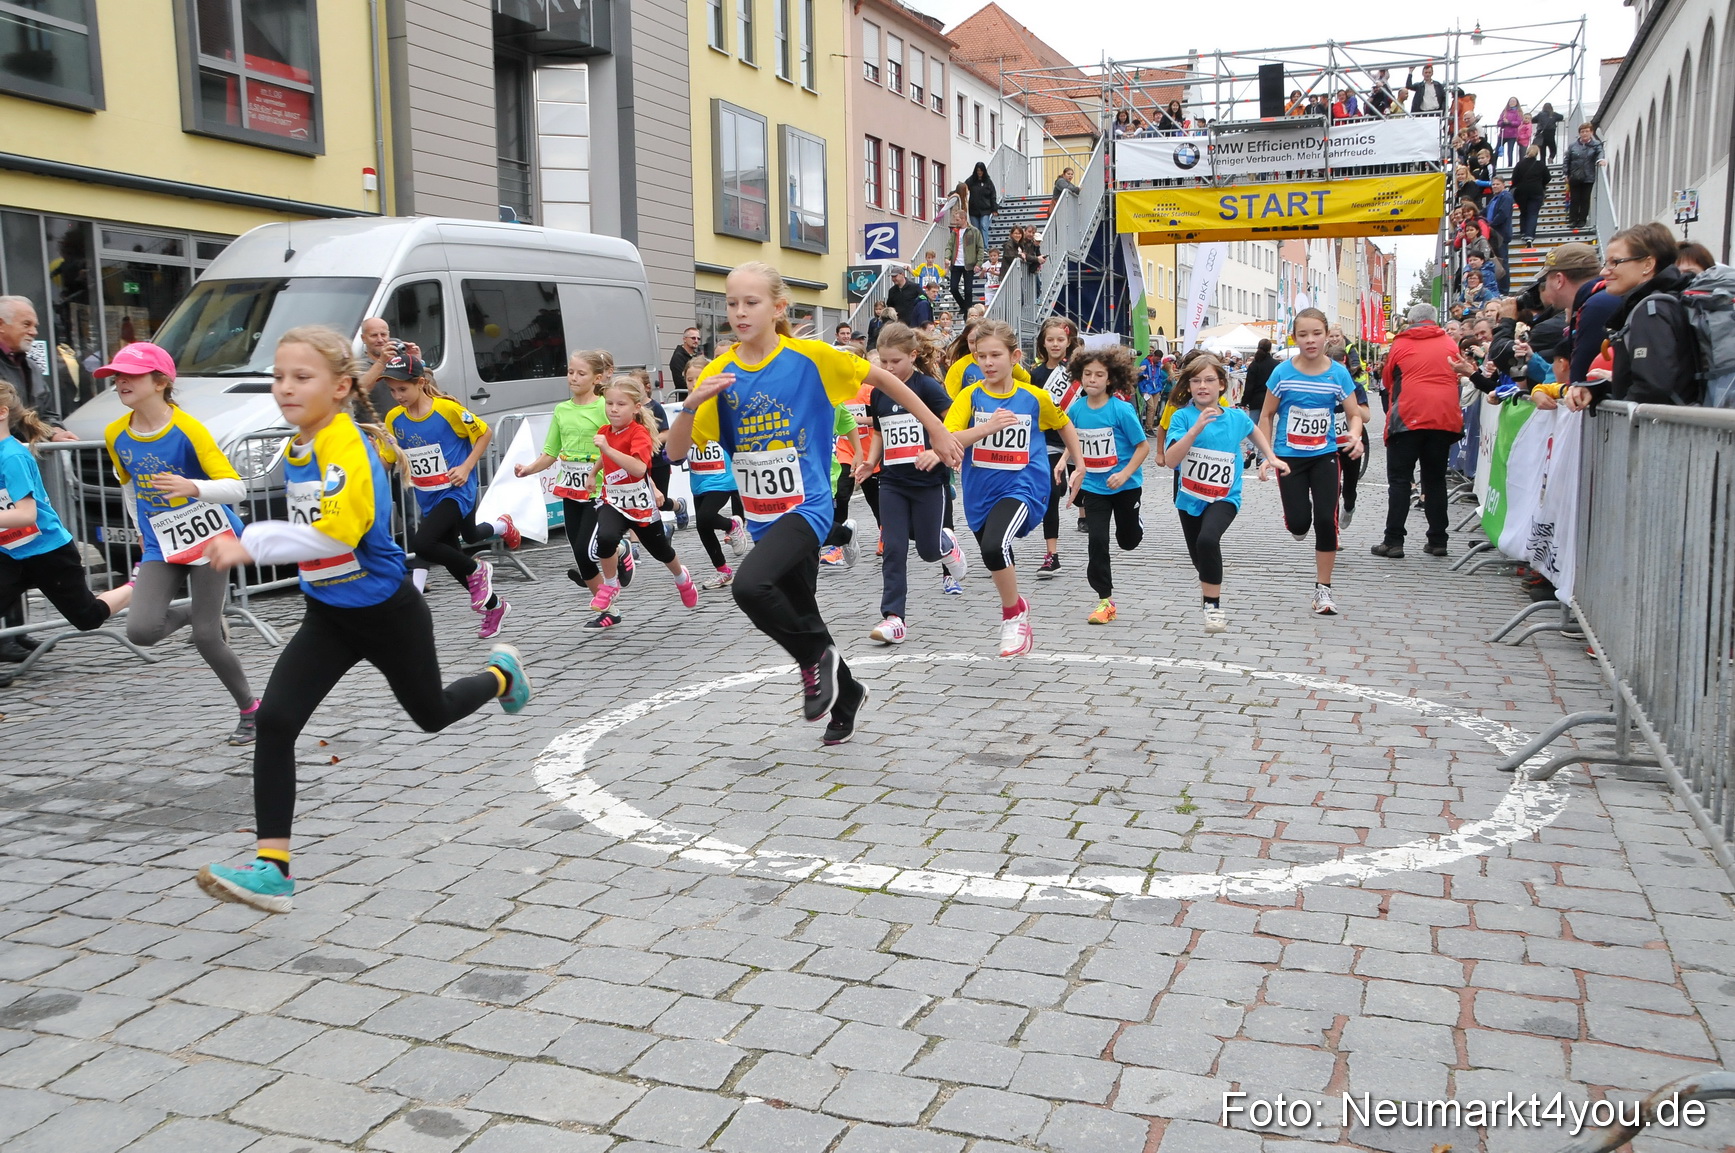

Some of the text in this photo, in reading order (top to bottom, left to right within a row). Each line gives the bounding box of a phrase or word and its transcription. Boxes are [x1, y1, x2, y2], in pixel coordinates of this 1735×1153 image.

[1207, 133, 1376, 155] BMW EfficientDynamics
[1207, 157, 1245, 167] Weniger
[1246, 153, 1295, 164] Verbrauch.
[1297, 151, 1321, 160] Mehr
[1218, 190, 1331, 221] START
[1351, 198, 1425, 209] Neumarkter Stadtlauf
[1192, 279, 1210, 329] Audi BKK
[1292, 417, 1328, 434] 7599
[884, 425, 920, 446] 7555
[690, 445, 720, 461] 7065
[749, 456, 784, 466] Neumarkt
[990, 452, 1014, 462] Maria
[1186, 451, 1229, 463] ARTL Neumarkt
[411, 456, 439, 476] 537
[1187, 459, 1231, 484] 7028
[737, 467, 795, 495] 7130
[611, 492, 649, 509] 7113
[752, 502, 786, 512] Victoria
[152, 515, 175, 530] PARTL
[173, 502, 207, 521] Neumarkt
[162, 508, 223, 551] 7560
